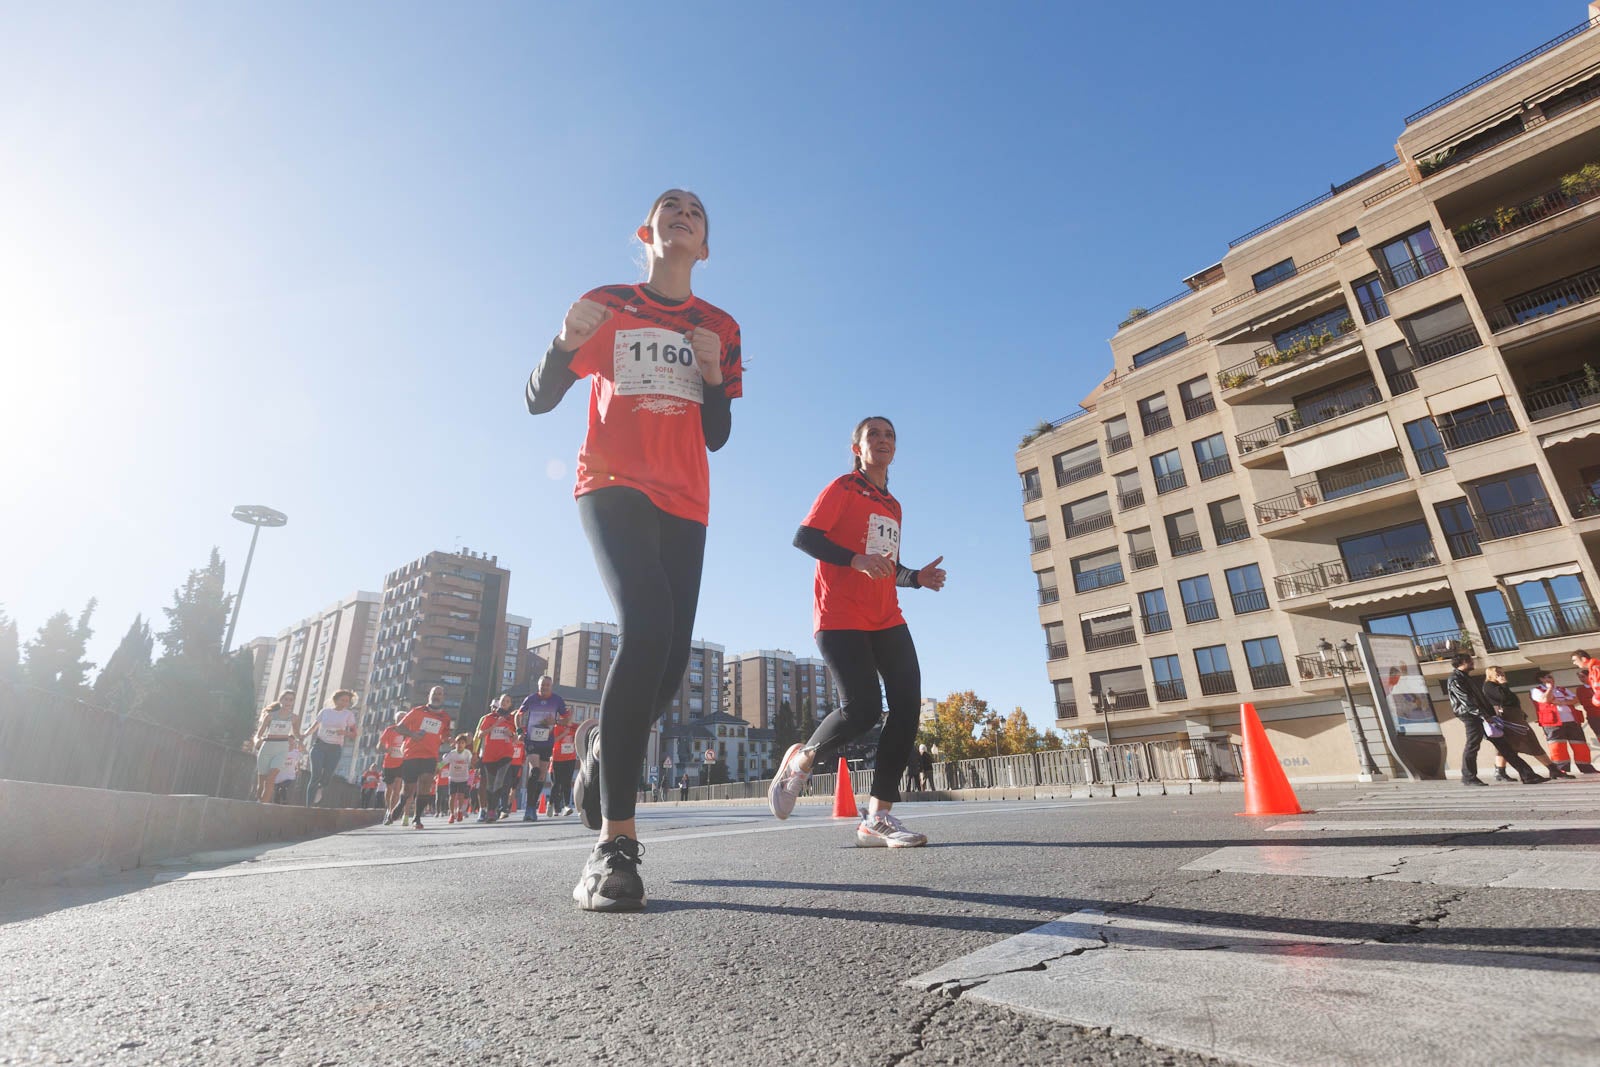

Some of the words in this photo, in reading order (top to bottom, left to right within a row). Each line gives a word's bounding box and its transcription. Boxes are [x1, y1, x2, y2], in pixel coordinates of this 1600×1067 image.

[629, 341, 692, 366] 1160
[655, 366, 674, 374] SOFIA
[1280, 756, 1310, 767] ONA
